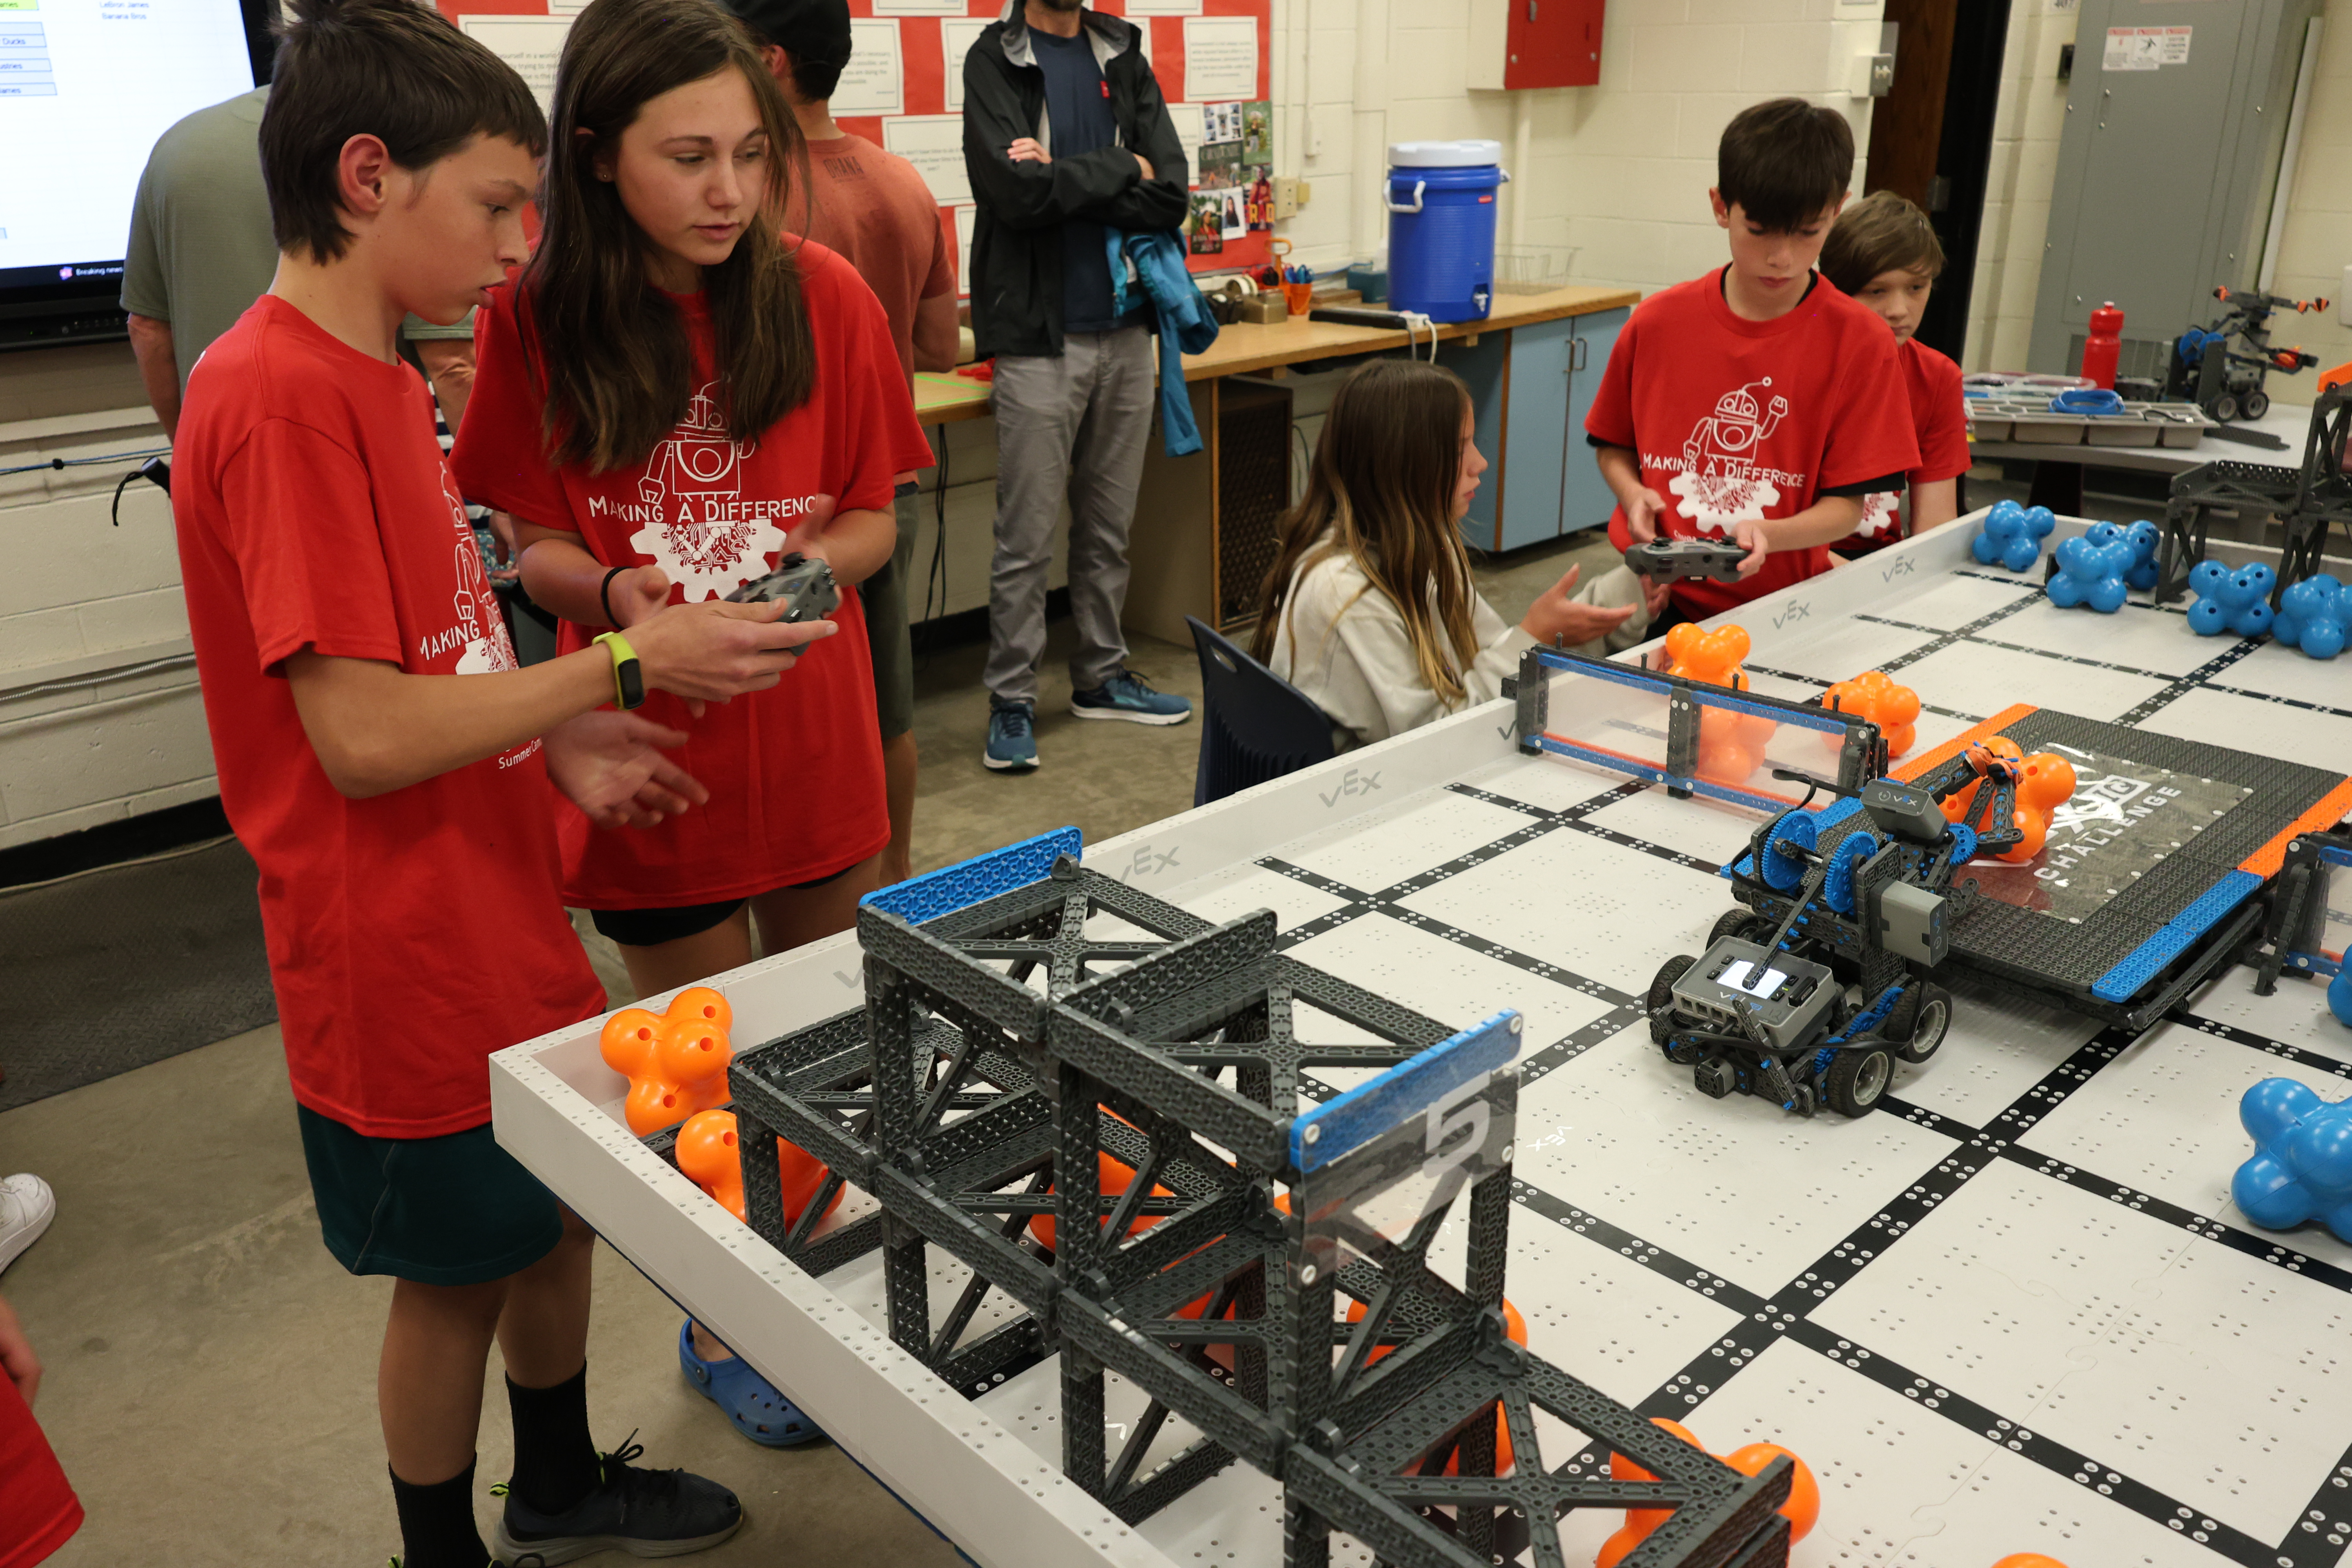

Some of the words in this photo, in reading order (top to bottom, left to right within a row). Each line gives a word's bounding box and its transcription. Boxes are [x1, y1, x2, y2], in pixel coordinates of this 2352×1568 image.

[823, 156, 864, 179] OHANA
[76, 268, 105, 276] Breaking
[1643, 453, 1697, 472] MAKING
[1704, 460, 1716, 476] A
[588, 495, 664, 523] MAKING
[677, 502, 694, 523] A
[706, 495, 817, 522] DIFFERENC
[1882, 555, 1916, 583] VEX
[1772, 599, 1811, 630] VEX
[498, 746, 532, 769] Summer
[1318, 768, 1382, 808] VEX
[1893, 787, 1918, 807] VEX
[2033, 786, 2182, 880] CHALLENGE
[1422, 1069, 1491, 1178] 5
[1525, 1125, 1575, 1152] VEX
